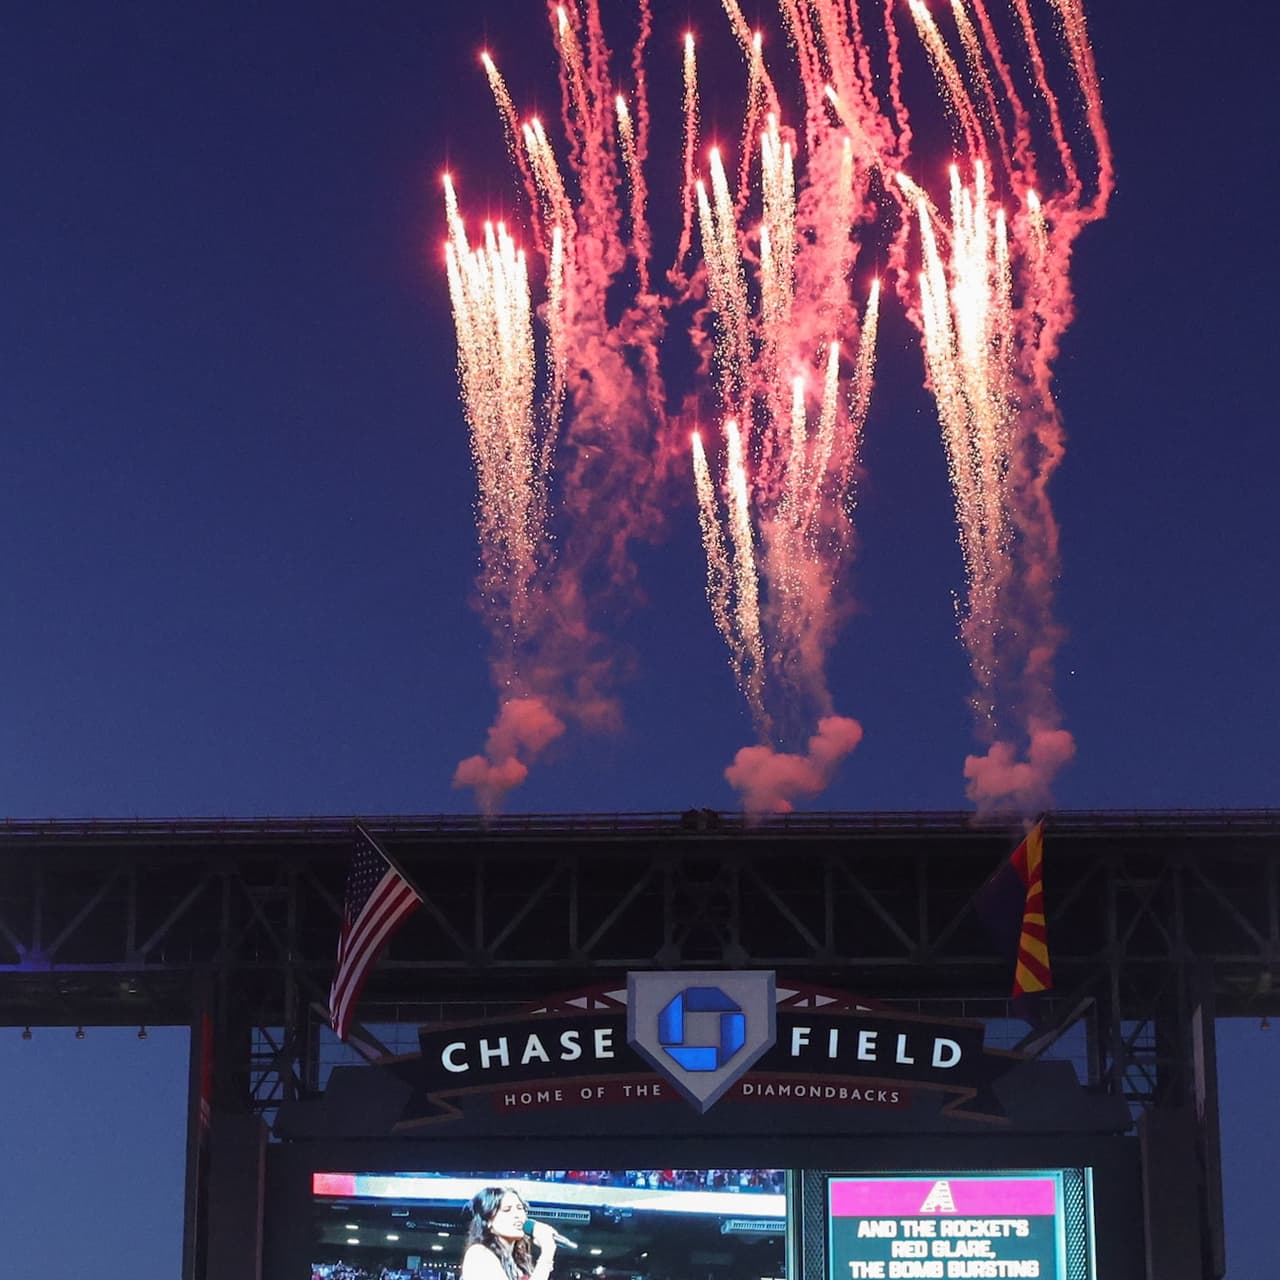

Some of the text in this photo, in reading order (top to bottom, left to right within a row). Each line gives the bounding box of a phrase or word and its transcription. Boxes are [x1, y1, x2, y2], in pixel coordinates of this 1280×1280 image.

[441, 1026, 961, 1073] CHASE FIELD
[505, 1083, 900, 1106] HOME OF THE DIAMONDBACKS
[858, 1220, 1029, 1238] AND THE ROCKET'S
[892, 1241, 928, 1258] RED
[849, 1261, 885, 1278] THE
